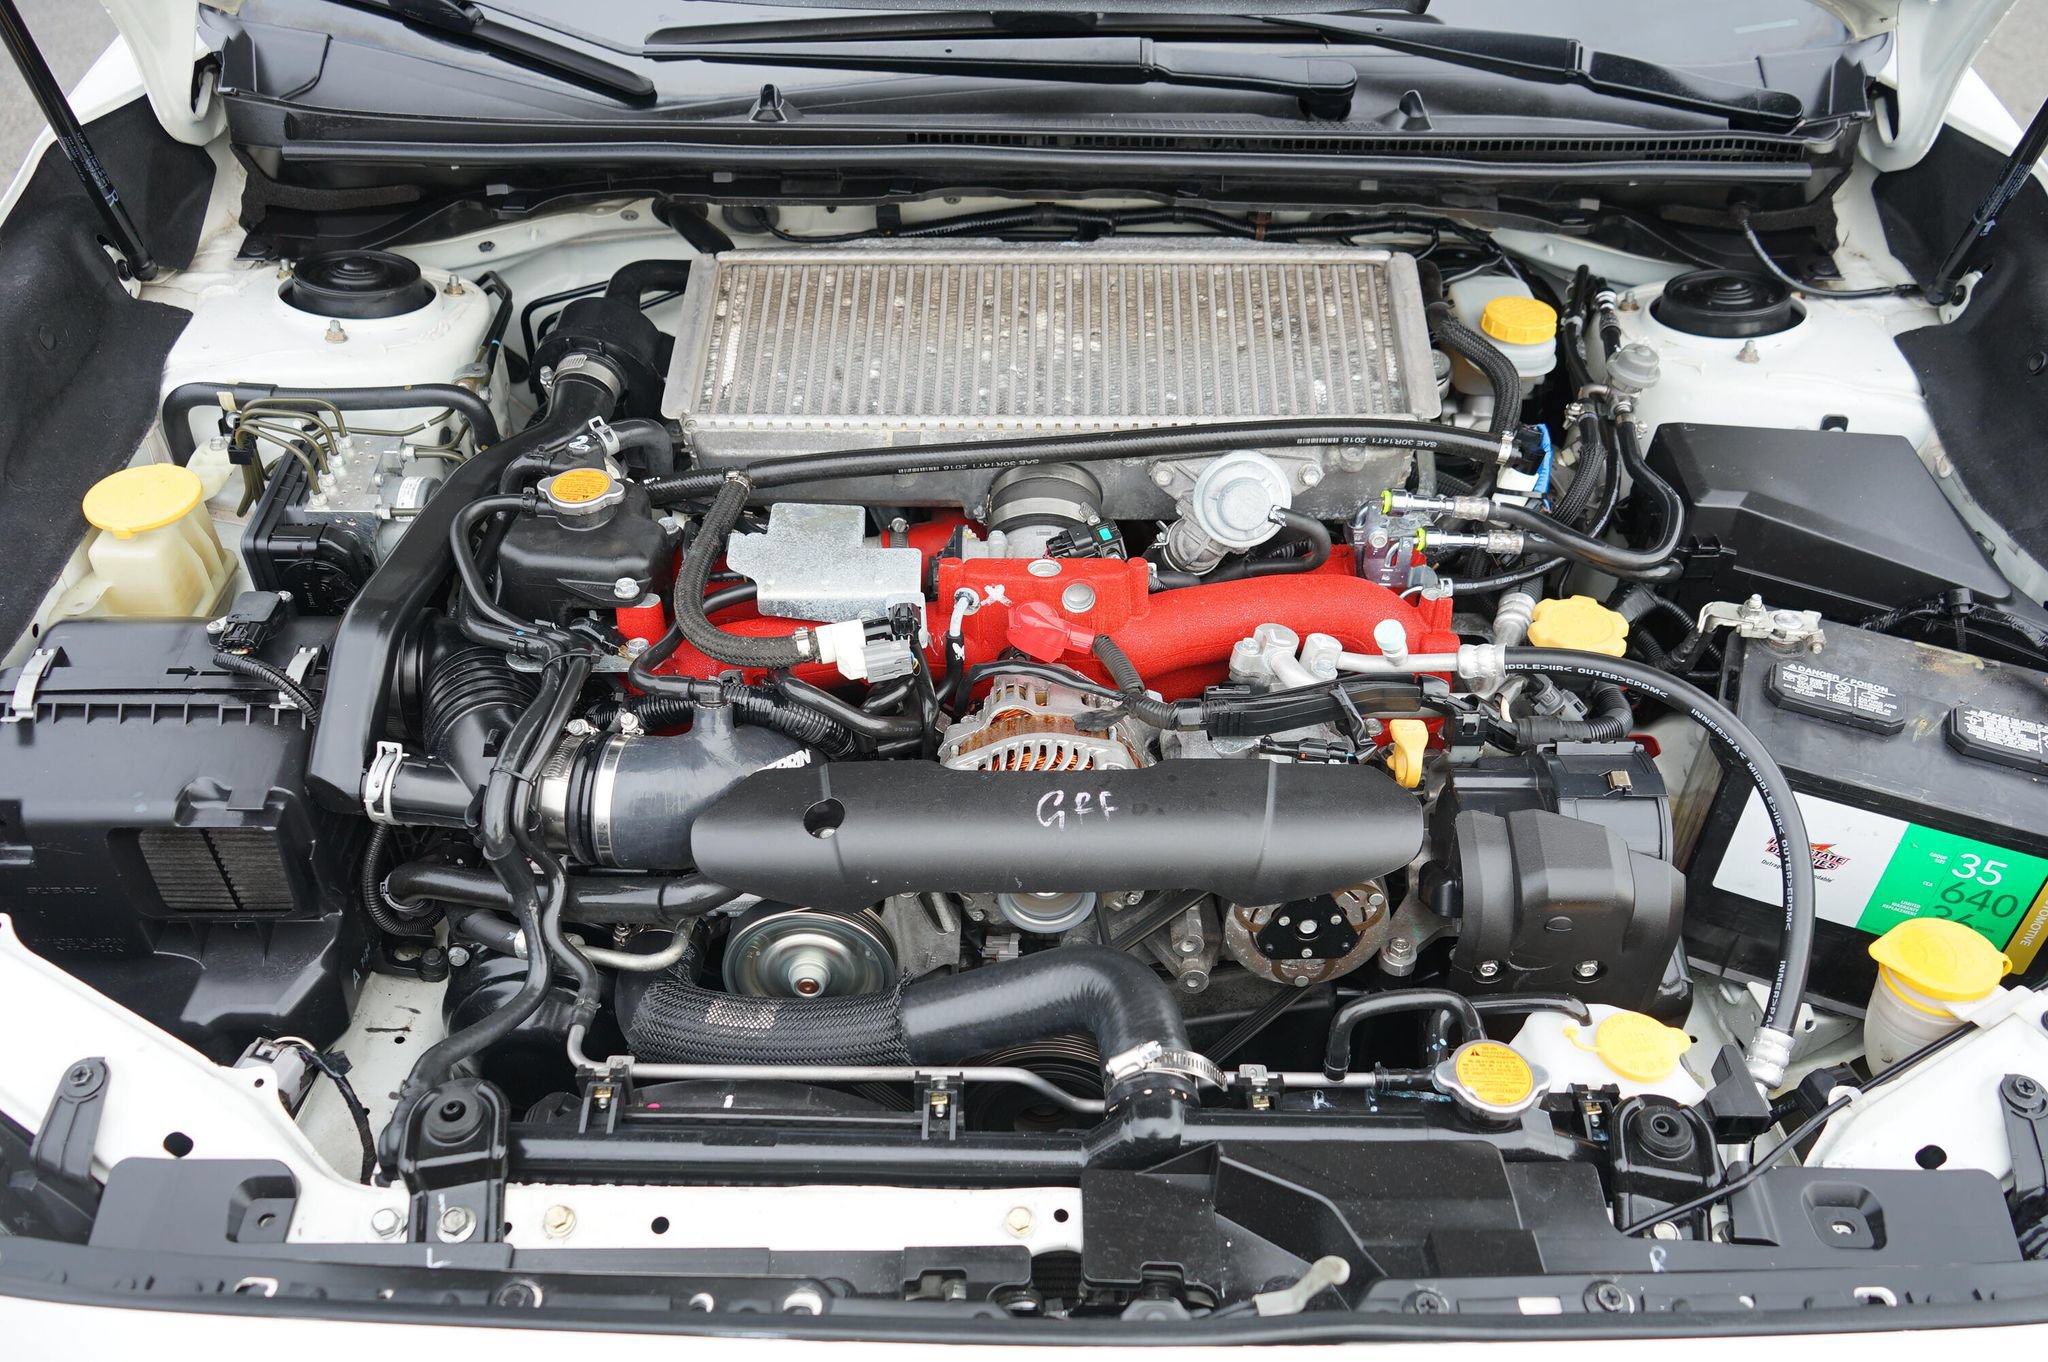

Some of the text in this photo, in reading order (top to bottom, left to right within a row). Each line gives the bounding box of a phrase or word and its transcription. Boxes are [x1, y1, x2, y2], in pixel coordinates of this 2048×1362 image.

[105, 189, 119, 207] R
[1417, 440, 1437, 448] SAE
[1798, 665, 1840, 681] DANGER
[1850, 678, 1889, 693] POISON
[1952, 853, 2008, 885] 35
[1940, 882, 2018, 918] 640
